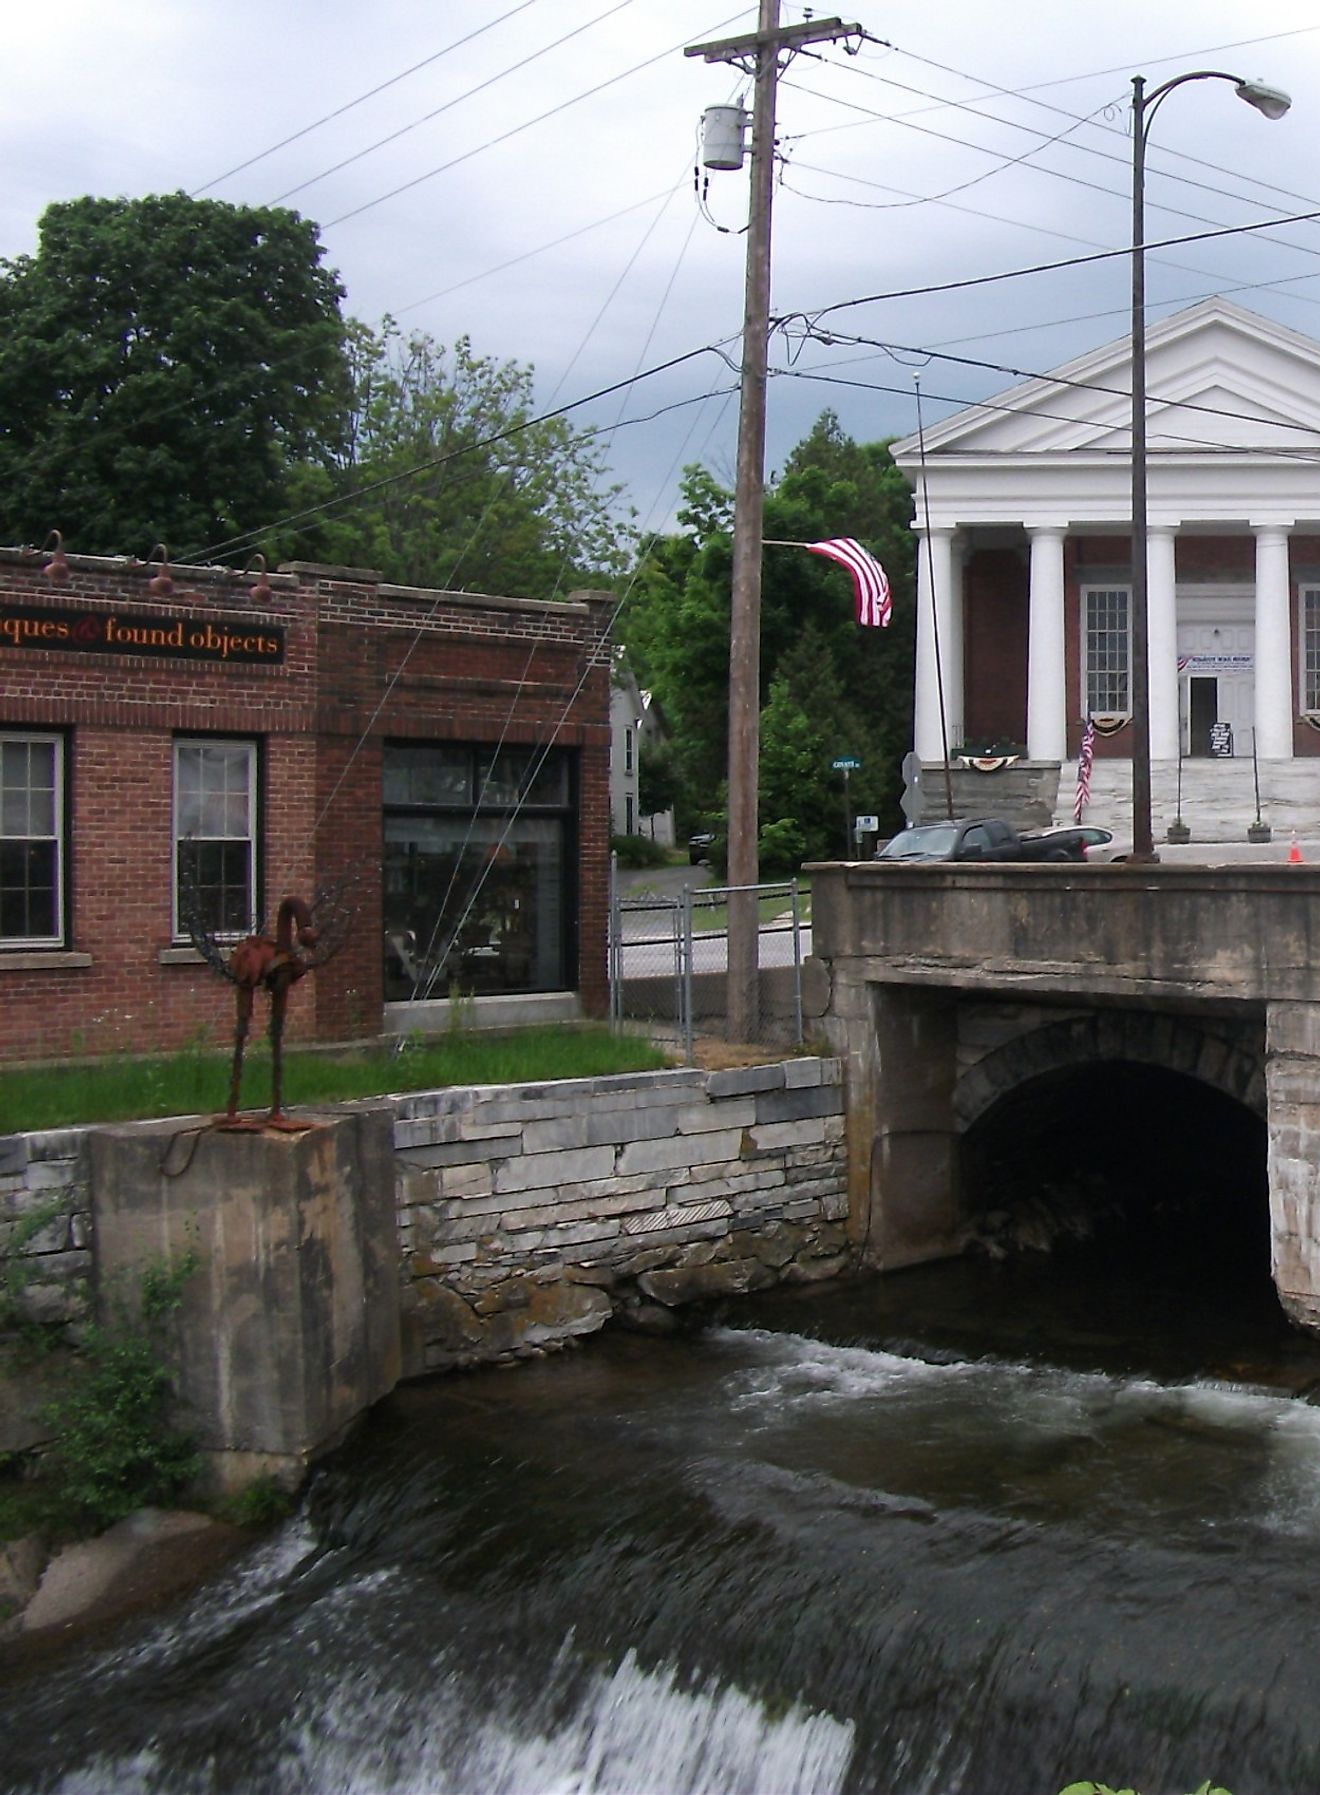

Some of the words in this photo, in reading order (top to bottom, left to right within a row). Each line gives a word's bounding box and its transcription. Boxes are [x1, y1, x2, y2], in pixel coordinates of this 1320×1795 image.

[0, 618, 70, 645] ques
[105, 615, 183, 648] found
[190, 624, 278, 658] objects
